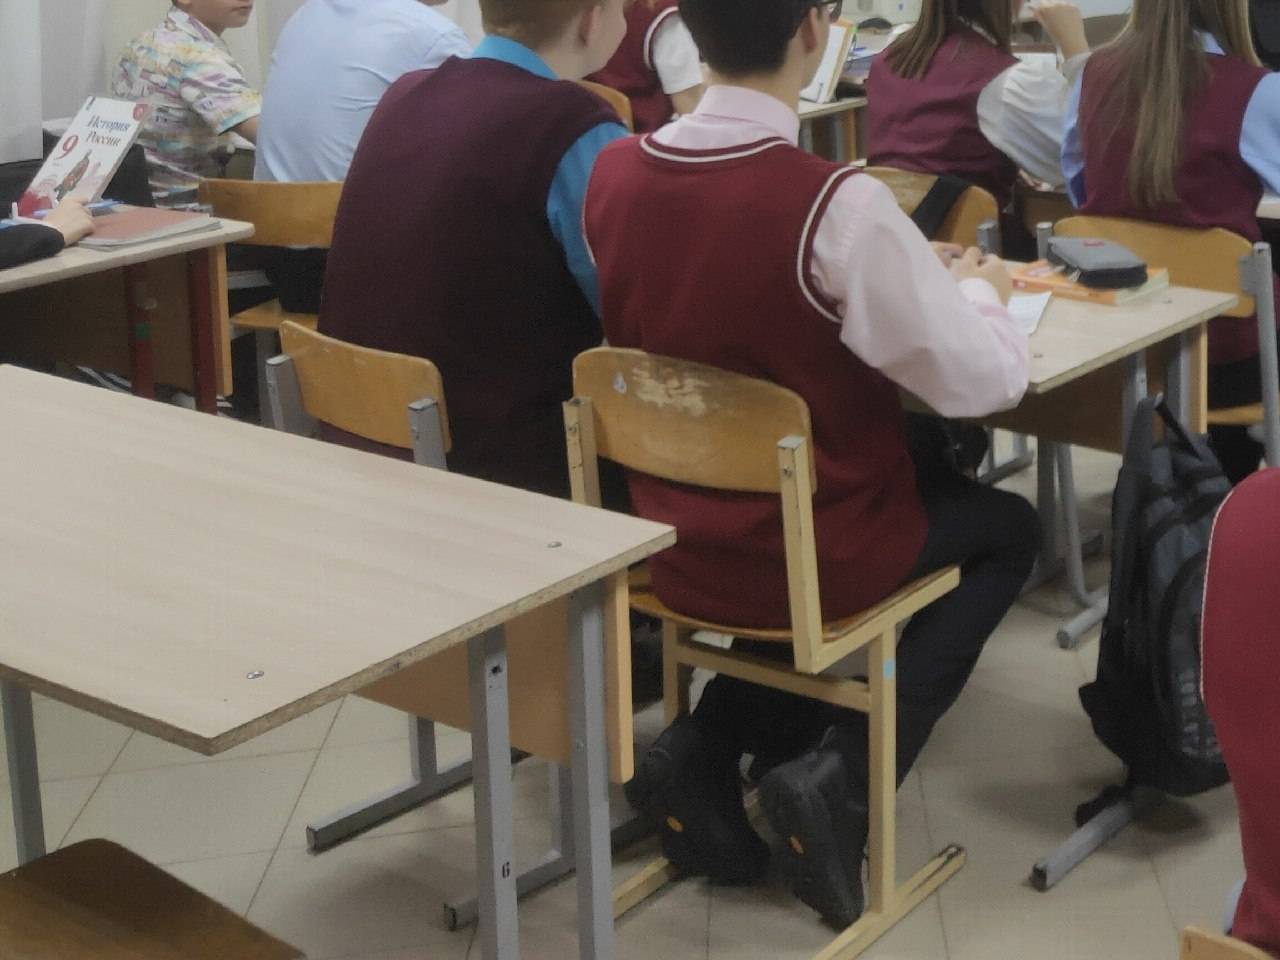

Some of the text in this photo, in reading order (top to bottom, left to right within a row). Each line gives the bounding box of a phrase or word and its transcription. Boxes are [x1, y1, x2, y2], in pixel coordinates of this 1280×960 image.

[87, 114, 130, 132] История
[53, 134, 79, 160] 9
[86, 130, 121, 147] России
